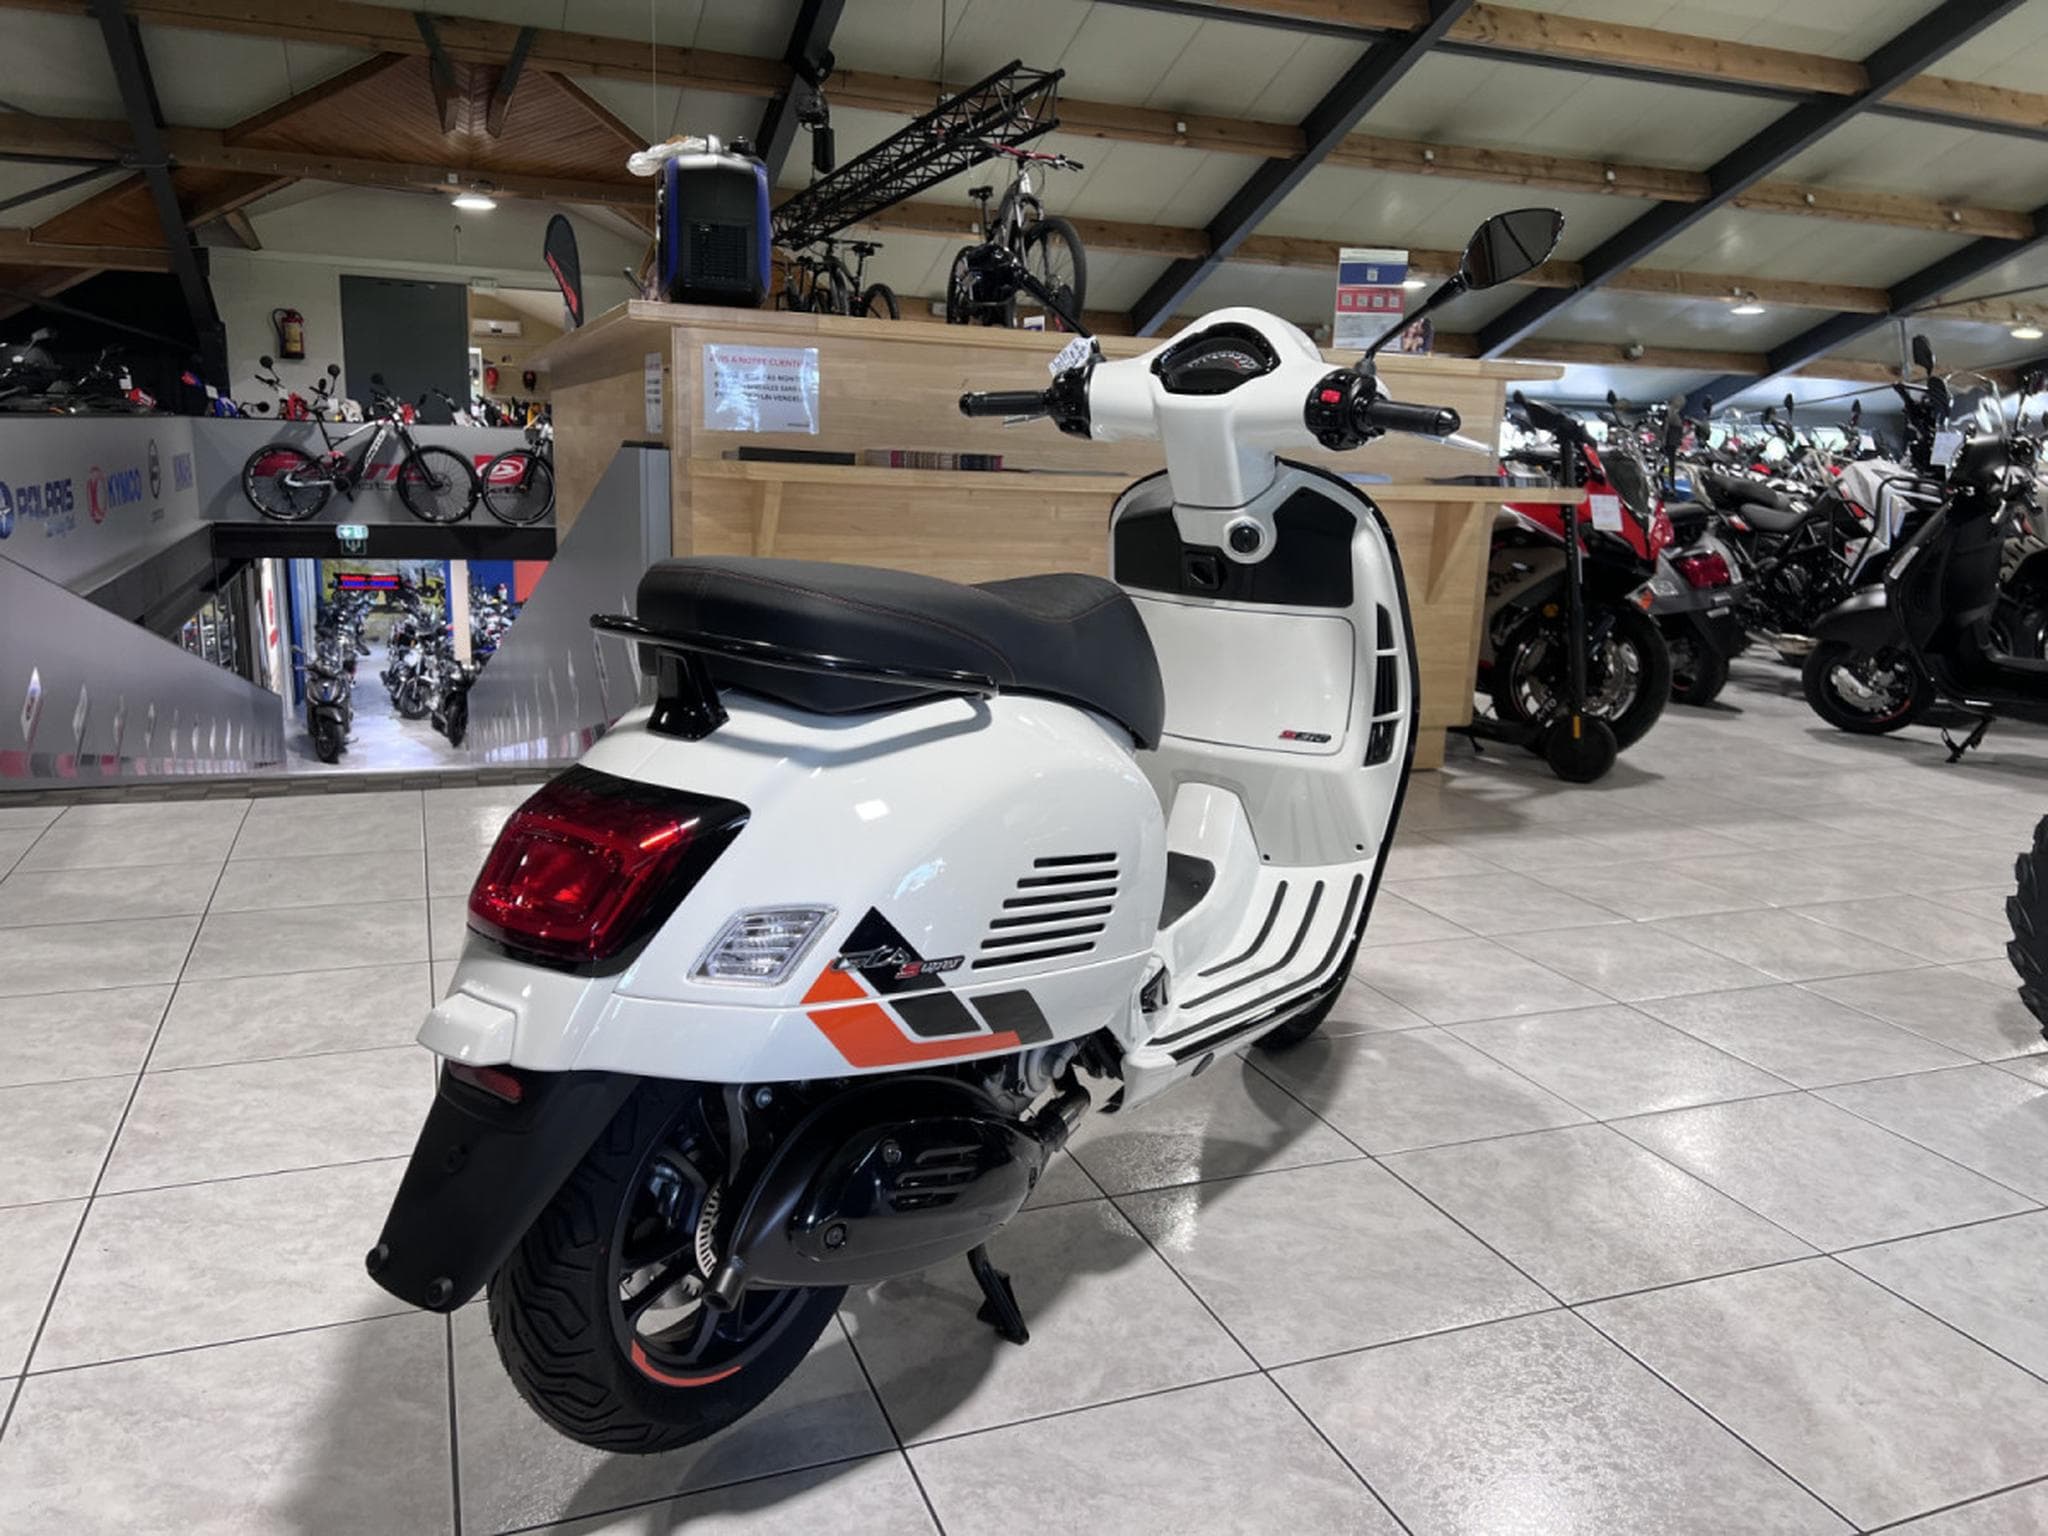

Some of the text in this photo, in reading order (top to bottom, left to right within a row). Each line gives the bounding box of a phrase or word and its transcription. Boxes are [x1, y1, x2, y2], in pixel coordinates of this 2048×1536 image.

[16, 477, 75, 518] POLARIS
[107, 467, 142, 509] KYMCO
[894, 955, 966, 980] Super
